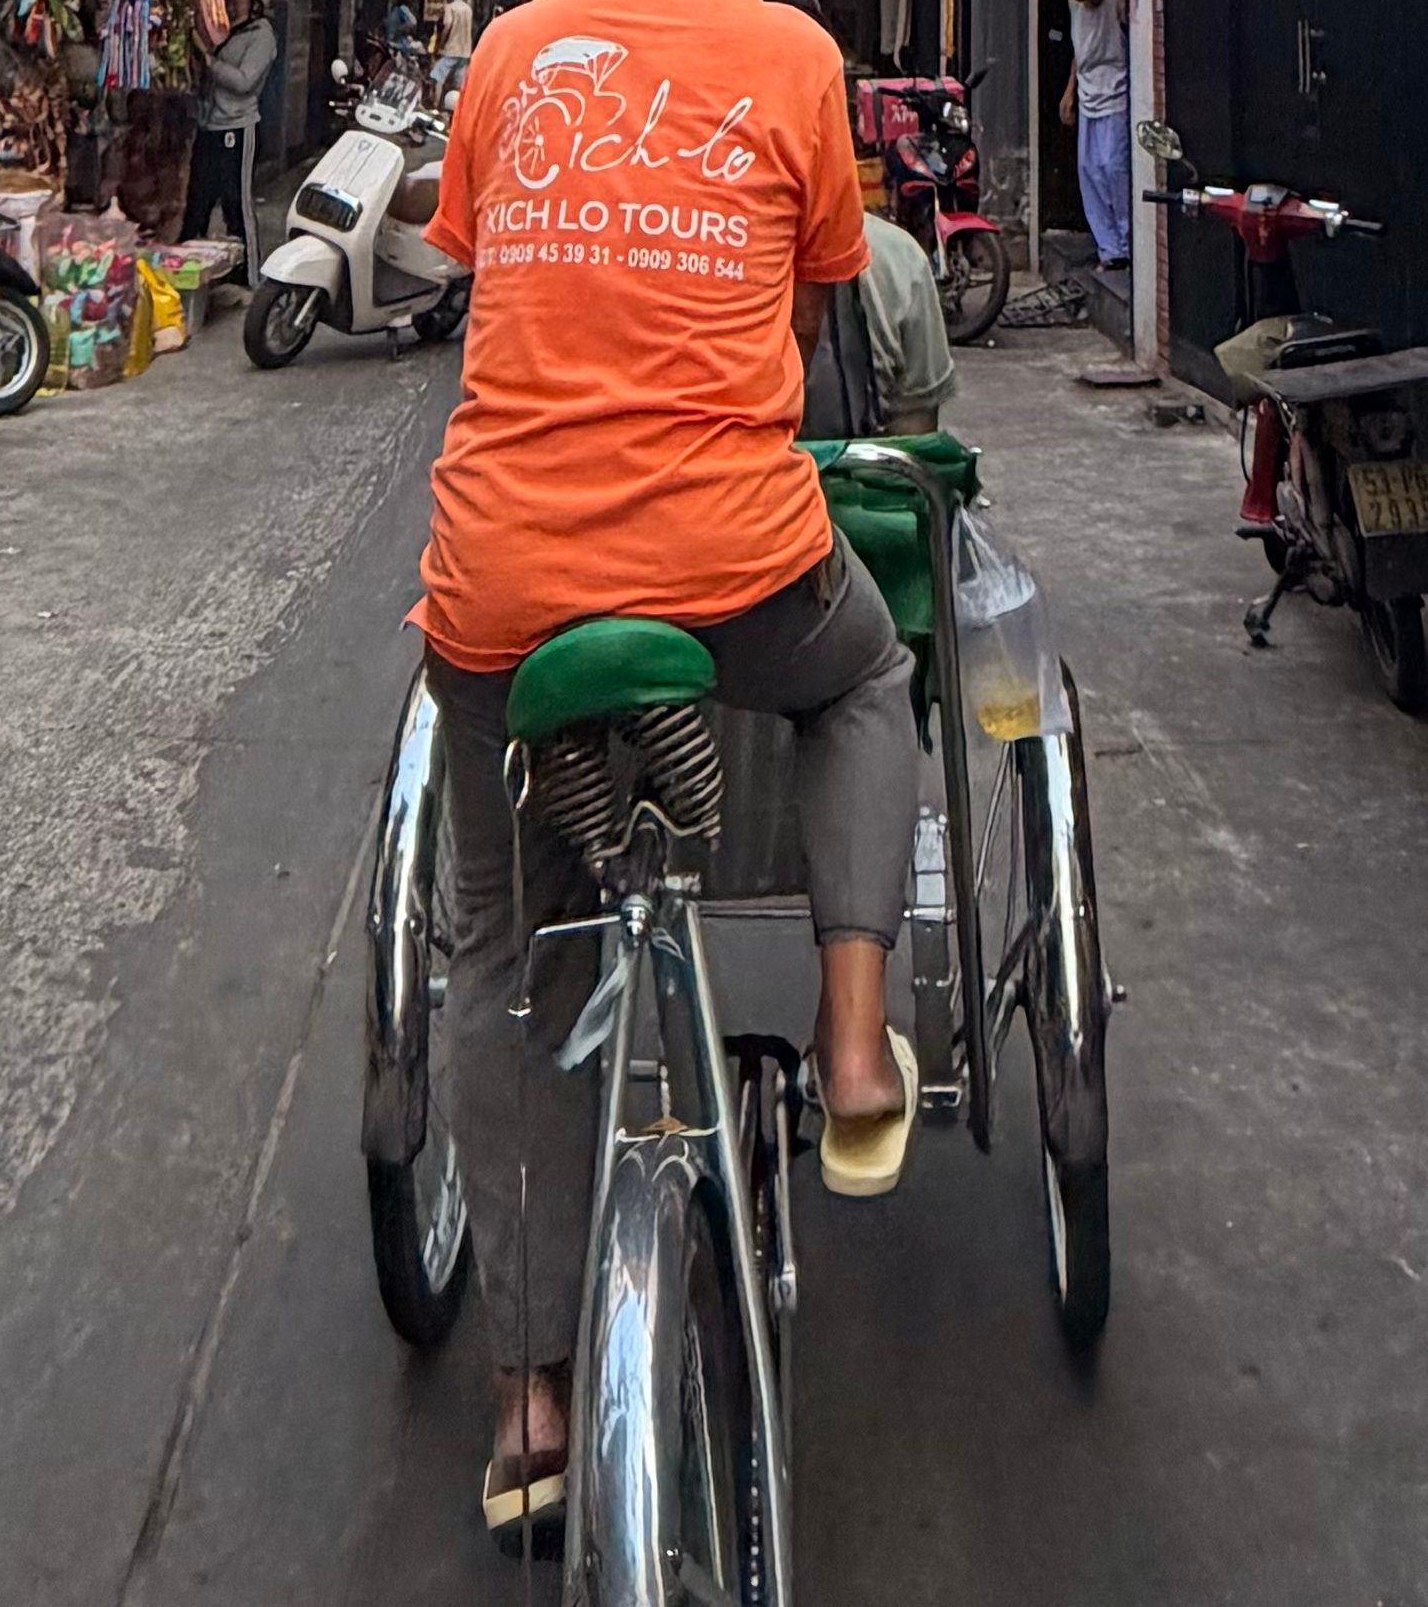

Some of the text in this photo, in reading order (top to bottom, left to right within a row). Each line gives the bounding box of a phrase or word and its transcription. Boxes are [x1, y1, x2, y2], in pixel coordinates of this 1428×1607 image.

[557, 198, 610, 233] LO
[618, 202, 750, 248] TOURS
[537, 242, 560, 263] 45
[562, 242, 586, 263] 39
[588, 244, 610, 265] 31
[627, 247, 672, 270] 0909
[675, 251, 710, 275] 306
[714, 257, 745, 281] 544
